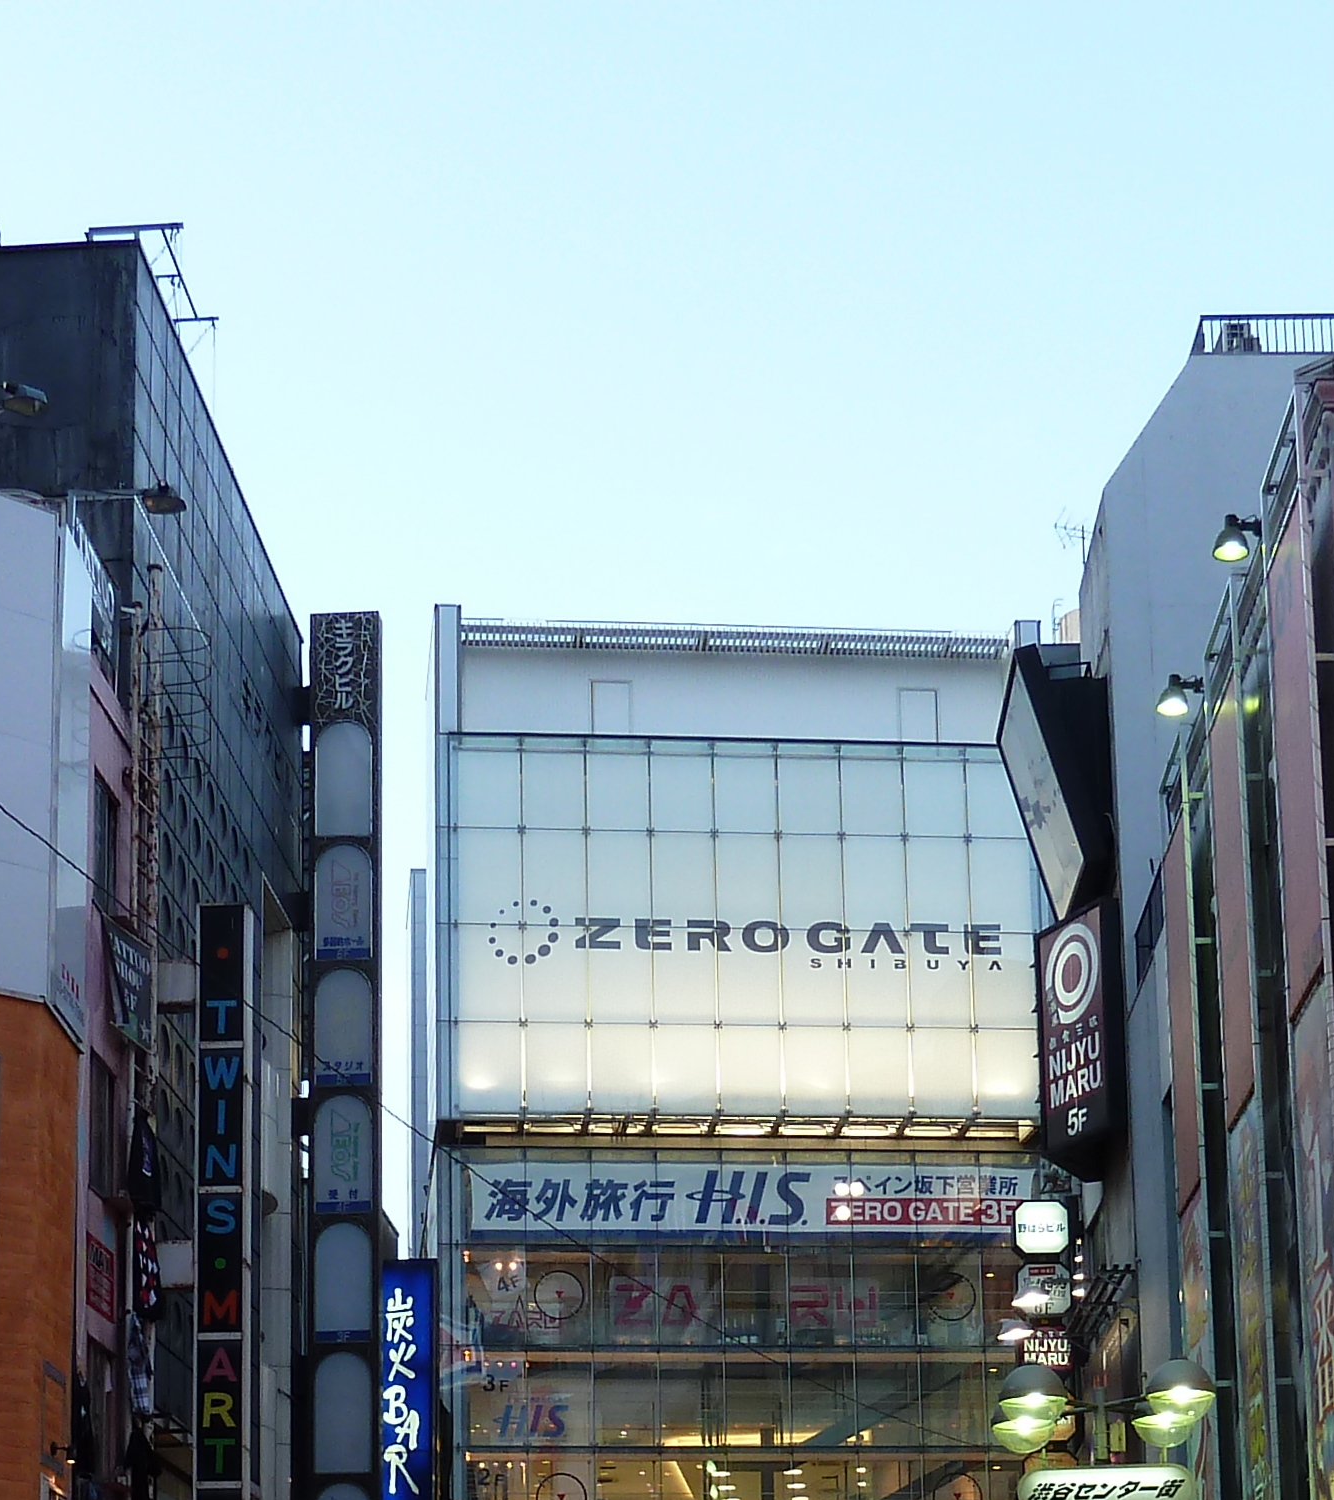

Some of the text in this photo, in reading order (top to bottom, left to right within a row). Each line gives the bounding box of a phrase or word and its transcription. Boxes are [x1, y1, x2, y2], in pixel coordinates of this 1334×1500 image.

[575, 916, 1003, 957] ZERO GATE
[809, 957, 1004, 972] SHIBUYA
[1048, 1030, 1101, 1081] NIJYU
[1049, 1059, 1103, 1109] MARU
[203, 1000, 242, 1235] TWINS
[1066, 1106, 1088, 1137] 5F
[483, 1177, 676, 1223] 海外旅行
[829, 1198, 1015, 1225] ZERO GATE 3F
[1017, 1222, 1066, 1234] 野はらビル
[1023, 1338, 1068, 1352] NIJYU
[1023, 1352, 1069, 1366] MARU
[199, 1287, 240, 1476] MART
